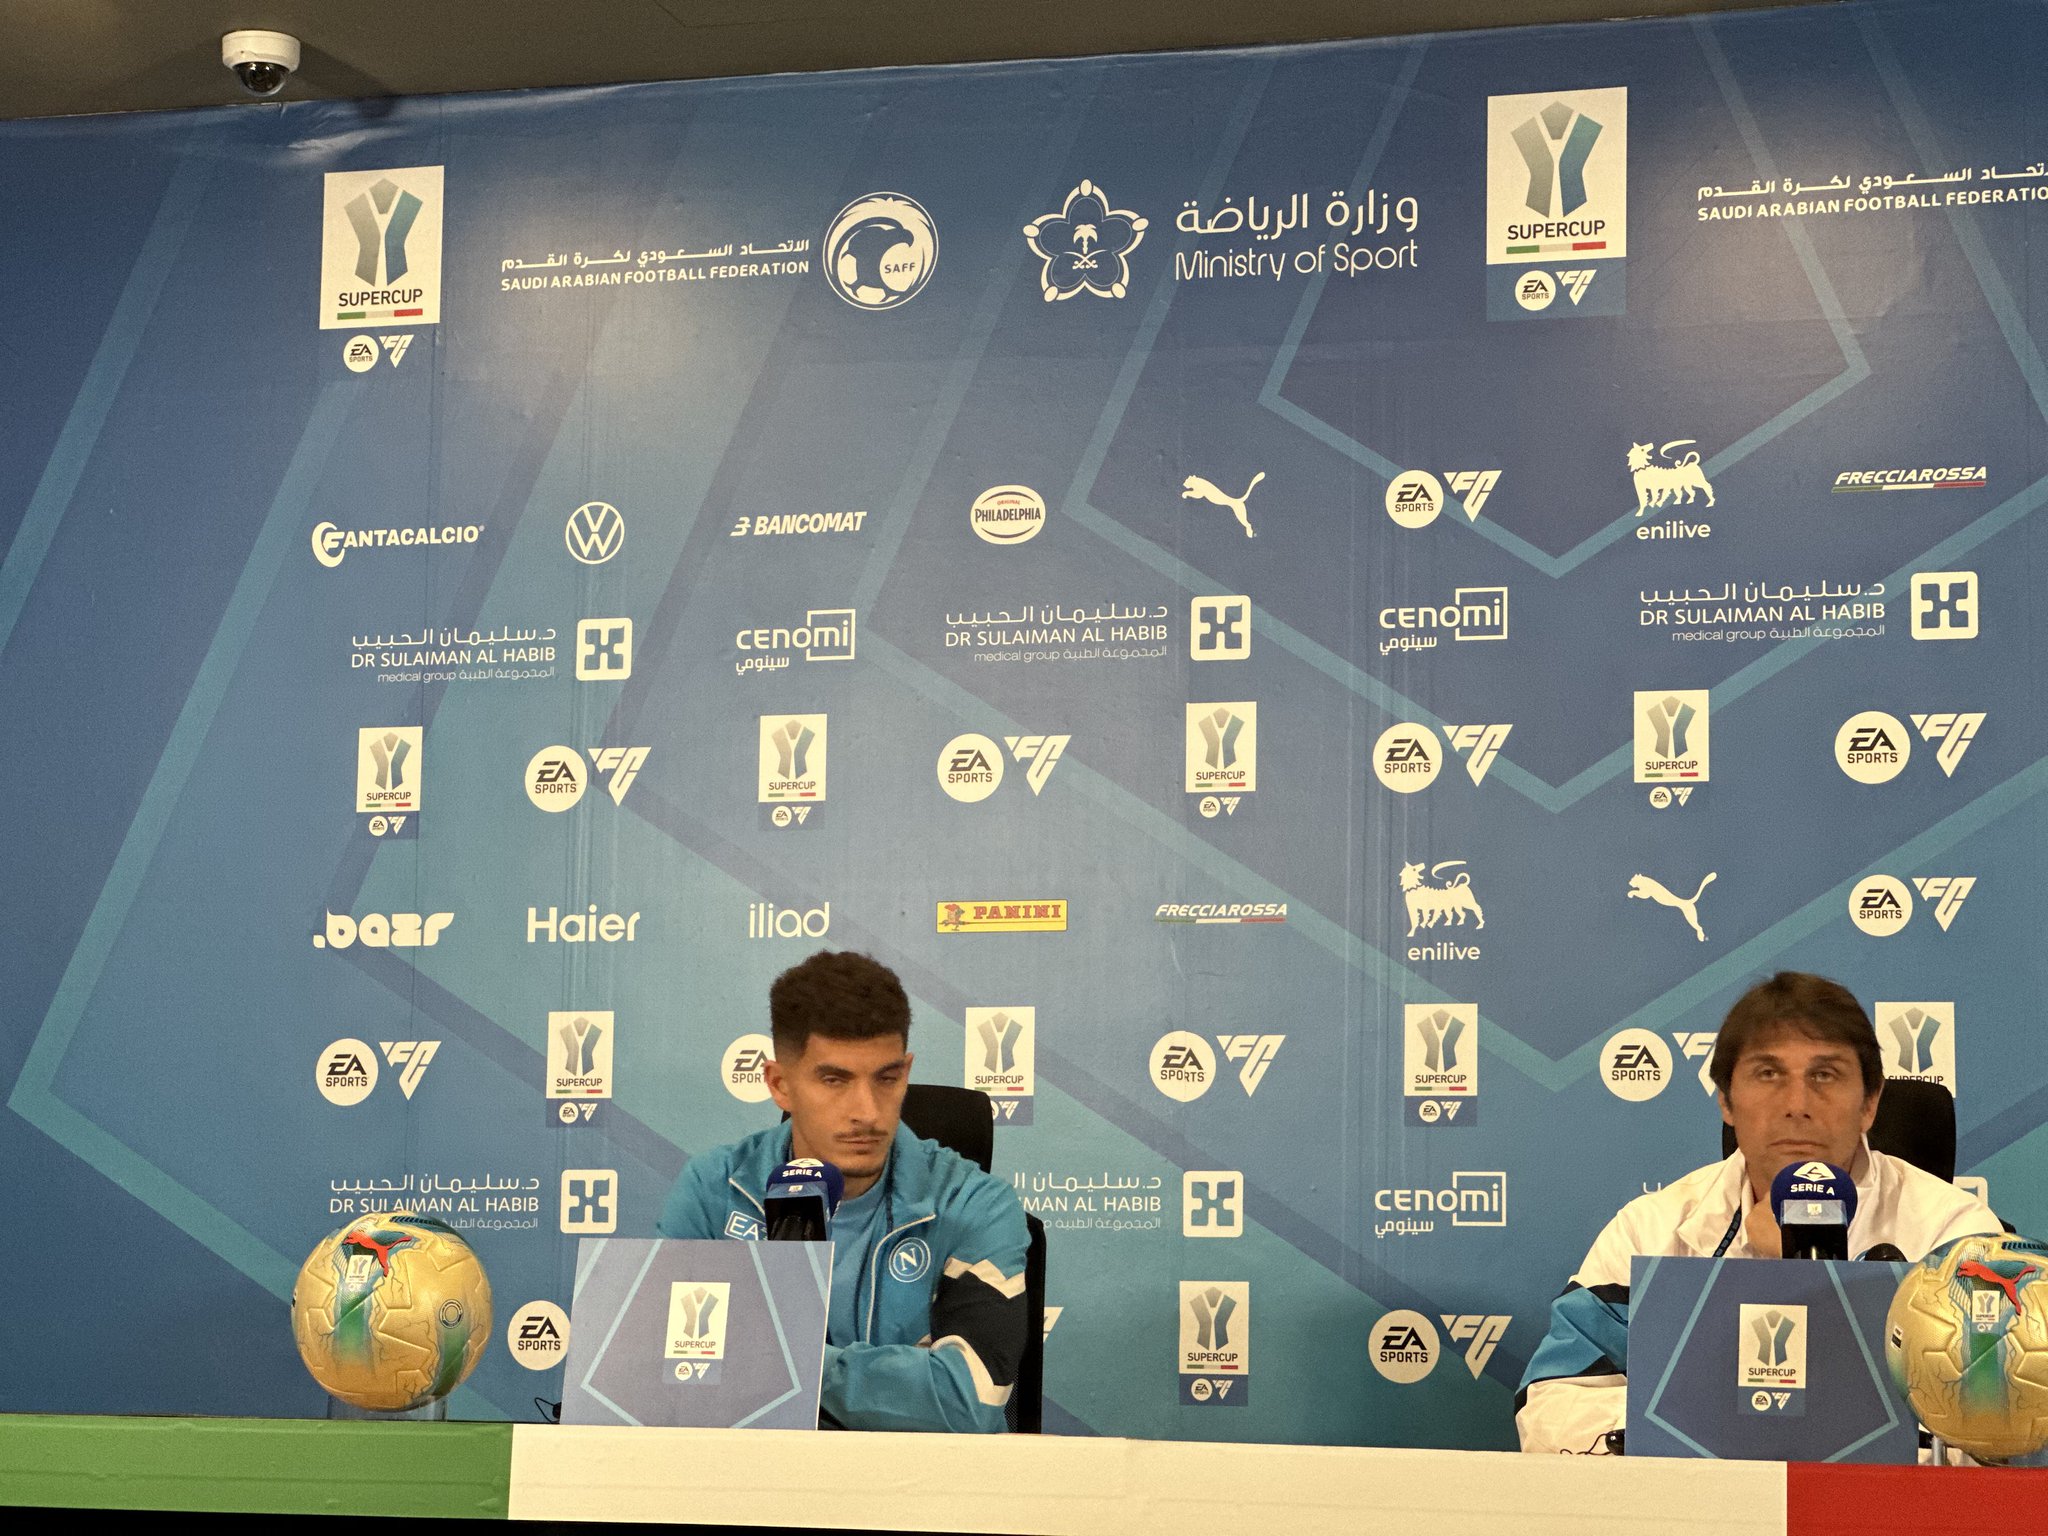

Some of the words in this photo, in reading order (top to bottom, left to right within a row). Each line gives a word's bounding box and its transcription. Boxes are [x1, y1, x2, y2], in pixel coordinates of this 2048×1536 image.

[1326, 189, 1418, 231] وزارة
[1698, 205, 1752, 220] SAUDI
[1756, 200, 1839, 217] ARABIAN
[1844, 194, 1941, 212] FOOTBALL
[1946, 187, 2048, 205] FEDERATIO
[1176, 193, 1308, 240] الرياضة
[1508, 220, 1605, 240] SUPERCUP
[885, 262, 915, 273] SAFF
[1176, 248, 1285, 281] Ministry
[1295, 244, 1325, 273] of
[1334, 239, 1417, 277] Sport
[502, 277, 547, 290] SAUDI
[551, 272, 620, 288] ARABIAN
[625, 268, 706, 284] FOOTBALL
[710, 261, 808, 278] FEDERATION
[1523, 280, 1548, 293] EA
[339, 289, 422, 306] SUPERCUP
[350, 344, 372, 356] EA
[1835, 466, 1987, 485] FRECCIAROSSA
[1396, 484, 1432, 502] EA
[975, 508, 1040, 522] PHILADELPHIA
[1395, 503, 1434, 512] SPORTS
[754, 512, 867, 535] BANCOMAT
[1637, 520, 1710, 539] enilive
[1641, 583, 1736, 606] الحبيب
[946, 606, 1033, 628] الحبيب
[1641, 610, 1668, 625] DR
[1675, 606, 1782, 624] SULAIMAN
[1790, 606, 1815, 620] AL
[1823, 603, 1884, 620] HABIB
[353, 629, 433, 650] الحبيب
[946, 632, 970, 646] DR
[978, 628, 1075, 646] SULAIMAN
[1082, 628, 1104, 642] AL
[1112, 625, 1167, 641] HABIB
[1672, 630, 1723, 641] medical
[1726, 630, 1766, 642] group
[1770, 627, 1810, 640] الطبية
[1380, 634, 1437, 655] سينومي
[352, 654, 374, 668] DR
[381, 650, 470, 666] SULAIMAN
[476, 649, 497, 663] AL
[504, 647, 555, 662] HABIB
[974, 650, 1021, 661] medical
[1024, 651, 1060, 663] group
[1063, 648, 1100, 660] الطبية
[736, 655, 789, 675] سينومي
[378, 672, 421, 682] medical
[423, 672, 456, 683] group
[459, 669, 492, 681] الطبية
[1849, 728, 1896, 751] EA
[1386, 739, 1429, 761] EA
[1848, 752, 1897, 763] SPORTS
[950, 750, 991, 772] EA
[1384, 762, 1430, 773] SPORTS
[1646, 761, 1698, 770] SUPERCUP
[536, 761, 575, 782] EA
[948, 772, 992, 783] SPORTS
[1196, 771, 1245, 780] SUPERCUP
[535, 783, 576, 794] SPORTS
[769, 781, 816, 790] SUPERCUP
[367, 792, 411, 800] SUPERCUP
[1861, 889, 1900, 908] EA
[973, 904, 1062, 920] PANINI
[1155, 903, 1288, 918] FRECCIAROSSA
[1860, 910, 1902, 919] SPORTS
[528, 904, 640, 942] Haier
[750, 902, 829, 938] iliad
[1408, 942, 1480, 960] enilive
[327, 1054, 366, 1075] EA
[1162, 1046, 1203, 1070] EA
[1613, 1045, 1659, 1068] EA
[326, 1077, 367, 1087] SPORTS
[557, 1078, 602, 1086] SUPERCUP
[732, 1072, 766, 1084] SPOR
[975, 1076, 1024, 1084] SUPERCUP
[1161, 1070, 1204, 1082] SPORTS
[1416, 1075, 1466, 1083] SUPERCUP
[1612, 1070, 1660, 1080] SPORTS
[782, 1168, 812, 1178] SERIE
[814, 1170, 822, 1178] A
[331, 1174, 414, 1191] الحبيب
[1790, 1182, 1824, 1194] SERIE
[1826, 1186, 1835, 1196] A
[330, 1199, 354, 1213] DR
[458, 1198, 479, 1212] AL
[486, 1197, 538, 1212] HABIB
[1074, 1197, 1097, 1211] AL
[1104, 1197, 1160, 1211] HABIB
[1375, 1218, 1433, 1238] سينومي
[899, 1246, 917, 1272] N
[520, 1317, 559, 1338] EA
[518, 1340, 560, 1350] SPORTS
[1382, 1326, 1426, 1350] EA
[1188, 1353, 1238, 1362] SUPERCUP
[1380, 1352, 1428, 1363] SPORTS
[1749, 1368, 1796, 1376] SUPERCUP
